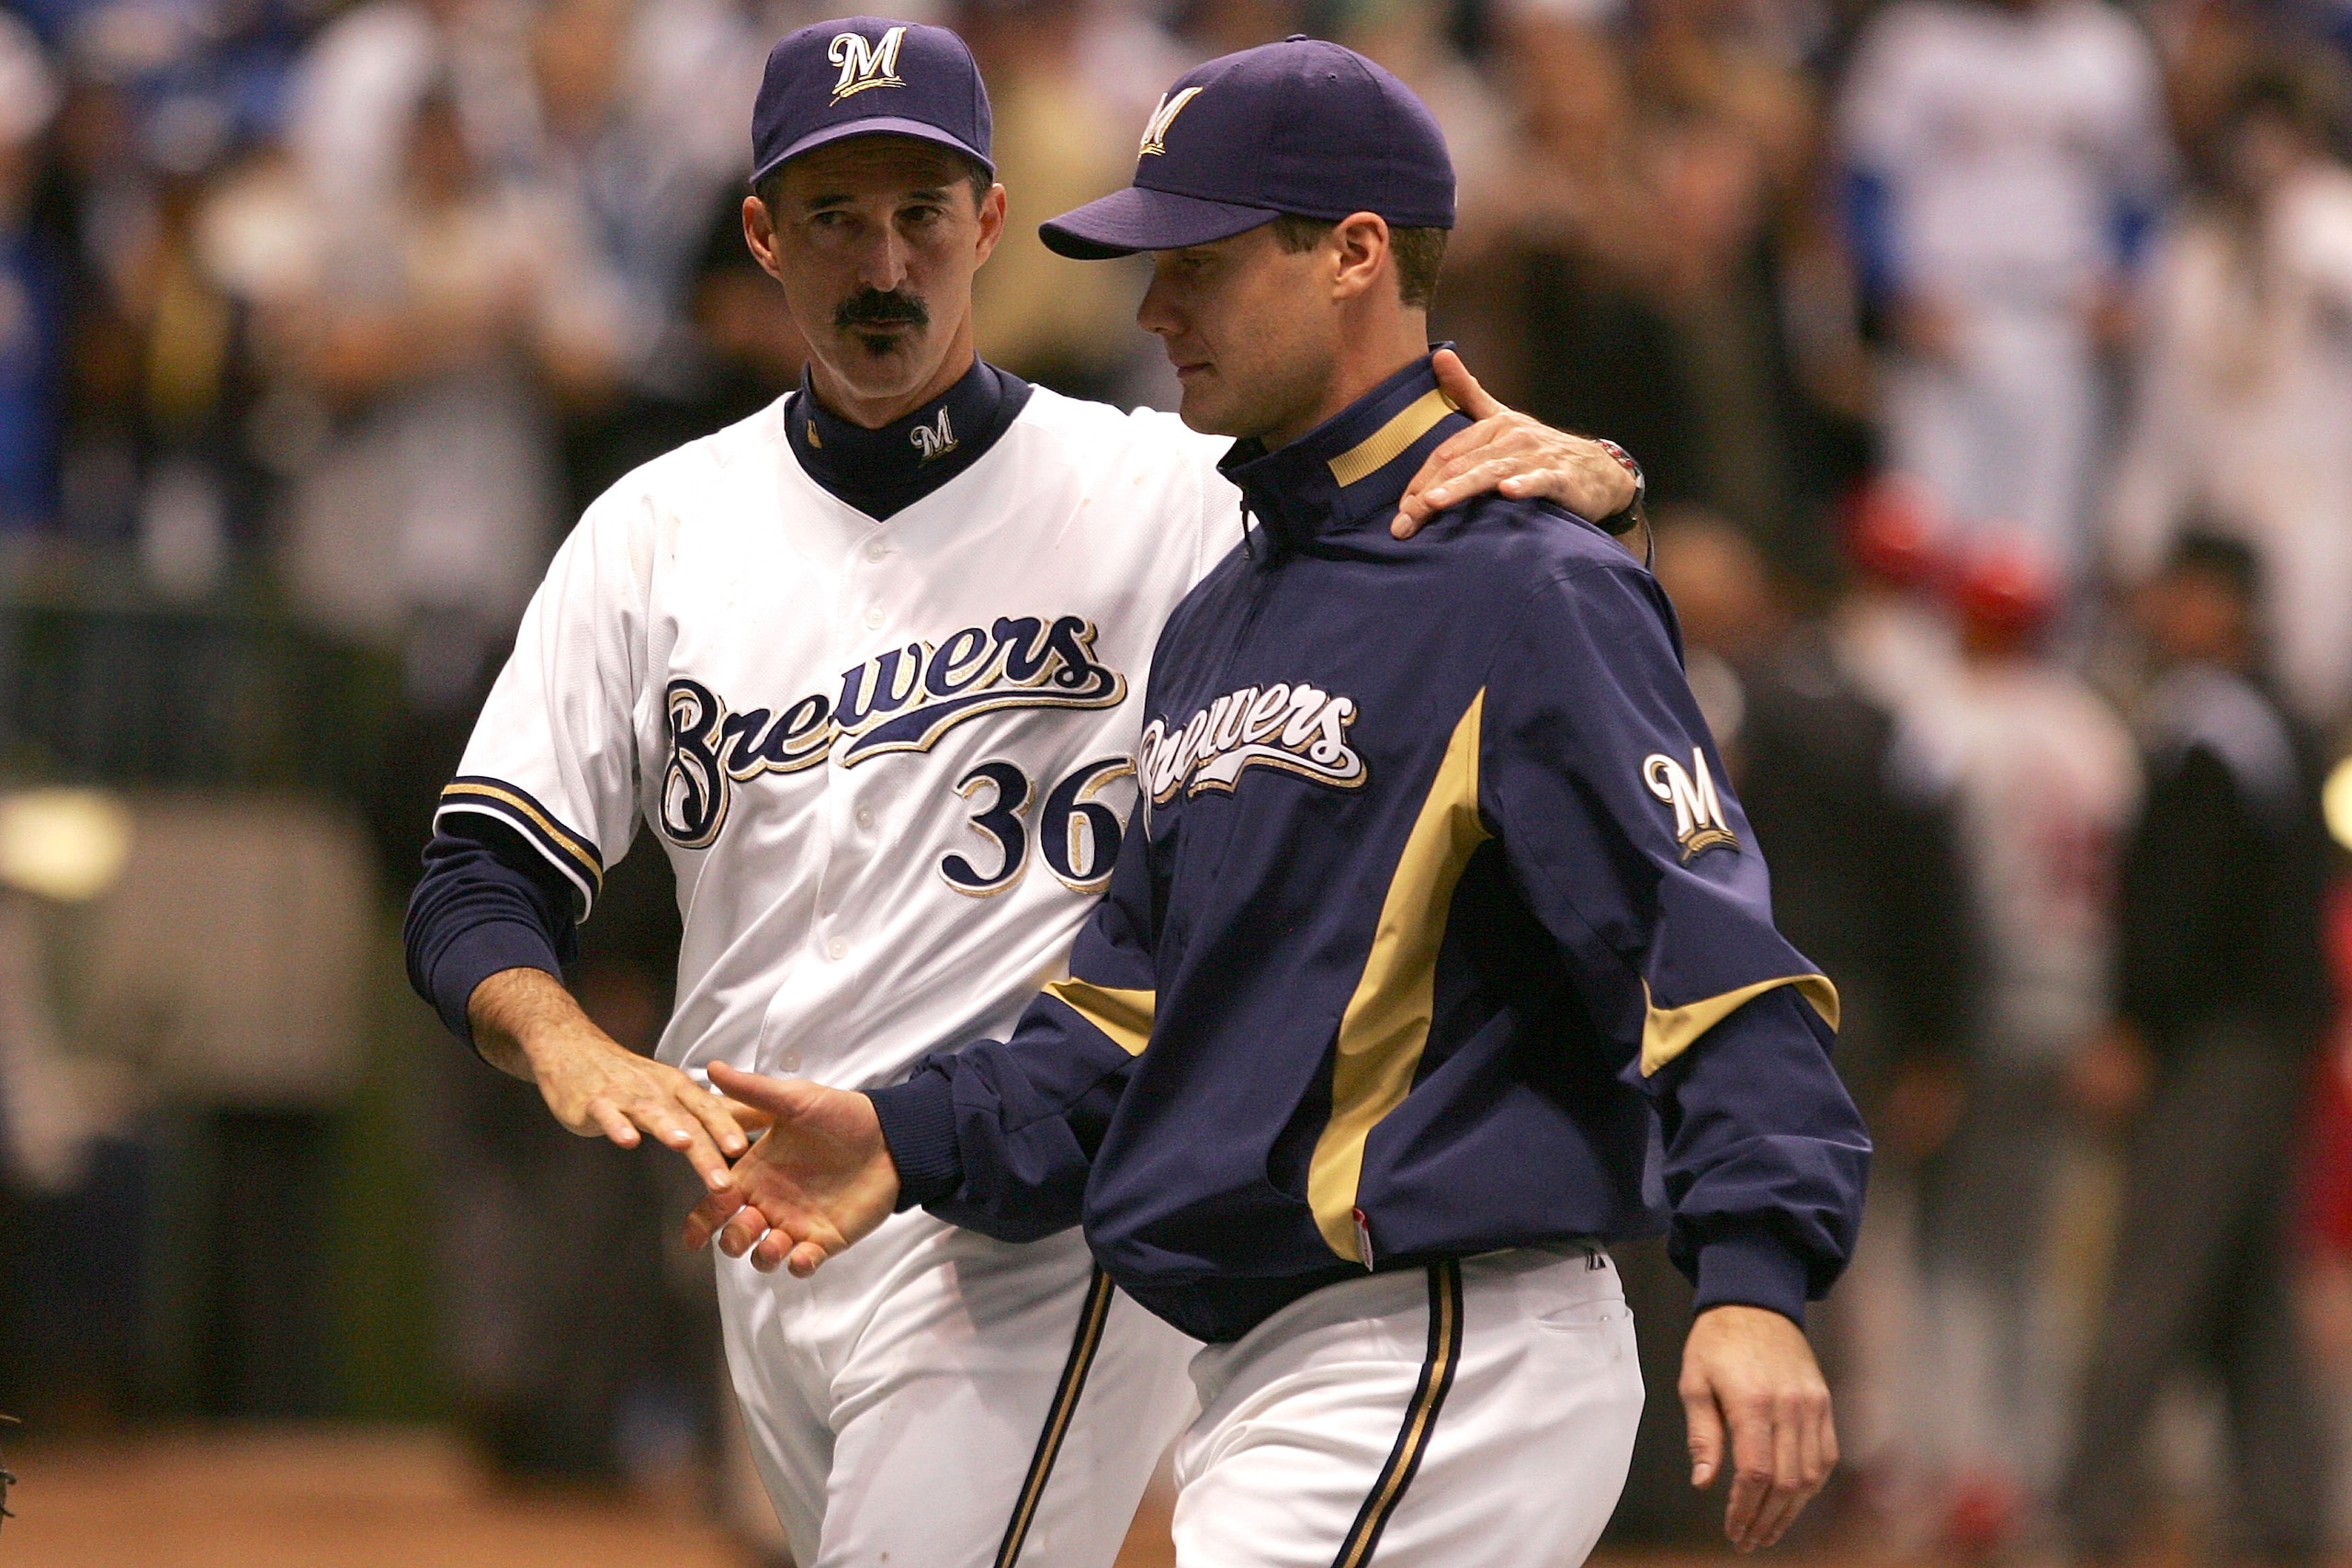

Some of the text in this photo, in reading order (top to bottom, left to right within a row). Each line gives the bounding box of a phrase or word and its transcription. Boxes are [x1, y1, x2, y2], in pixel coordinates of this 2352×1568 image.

[828, 26, 908, 97] M
[910, 405, 956, 458] M
[660, 615, 1126, 849] Brewers
[937, 757, 1136, 897] 36
[1643, 746, 1735, 845] M
